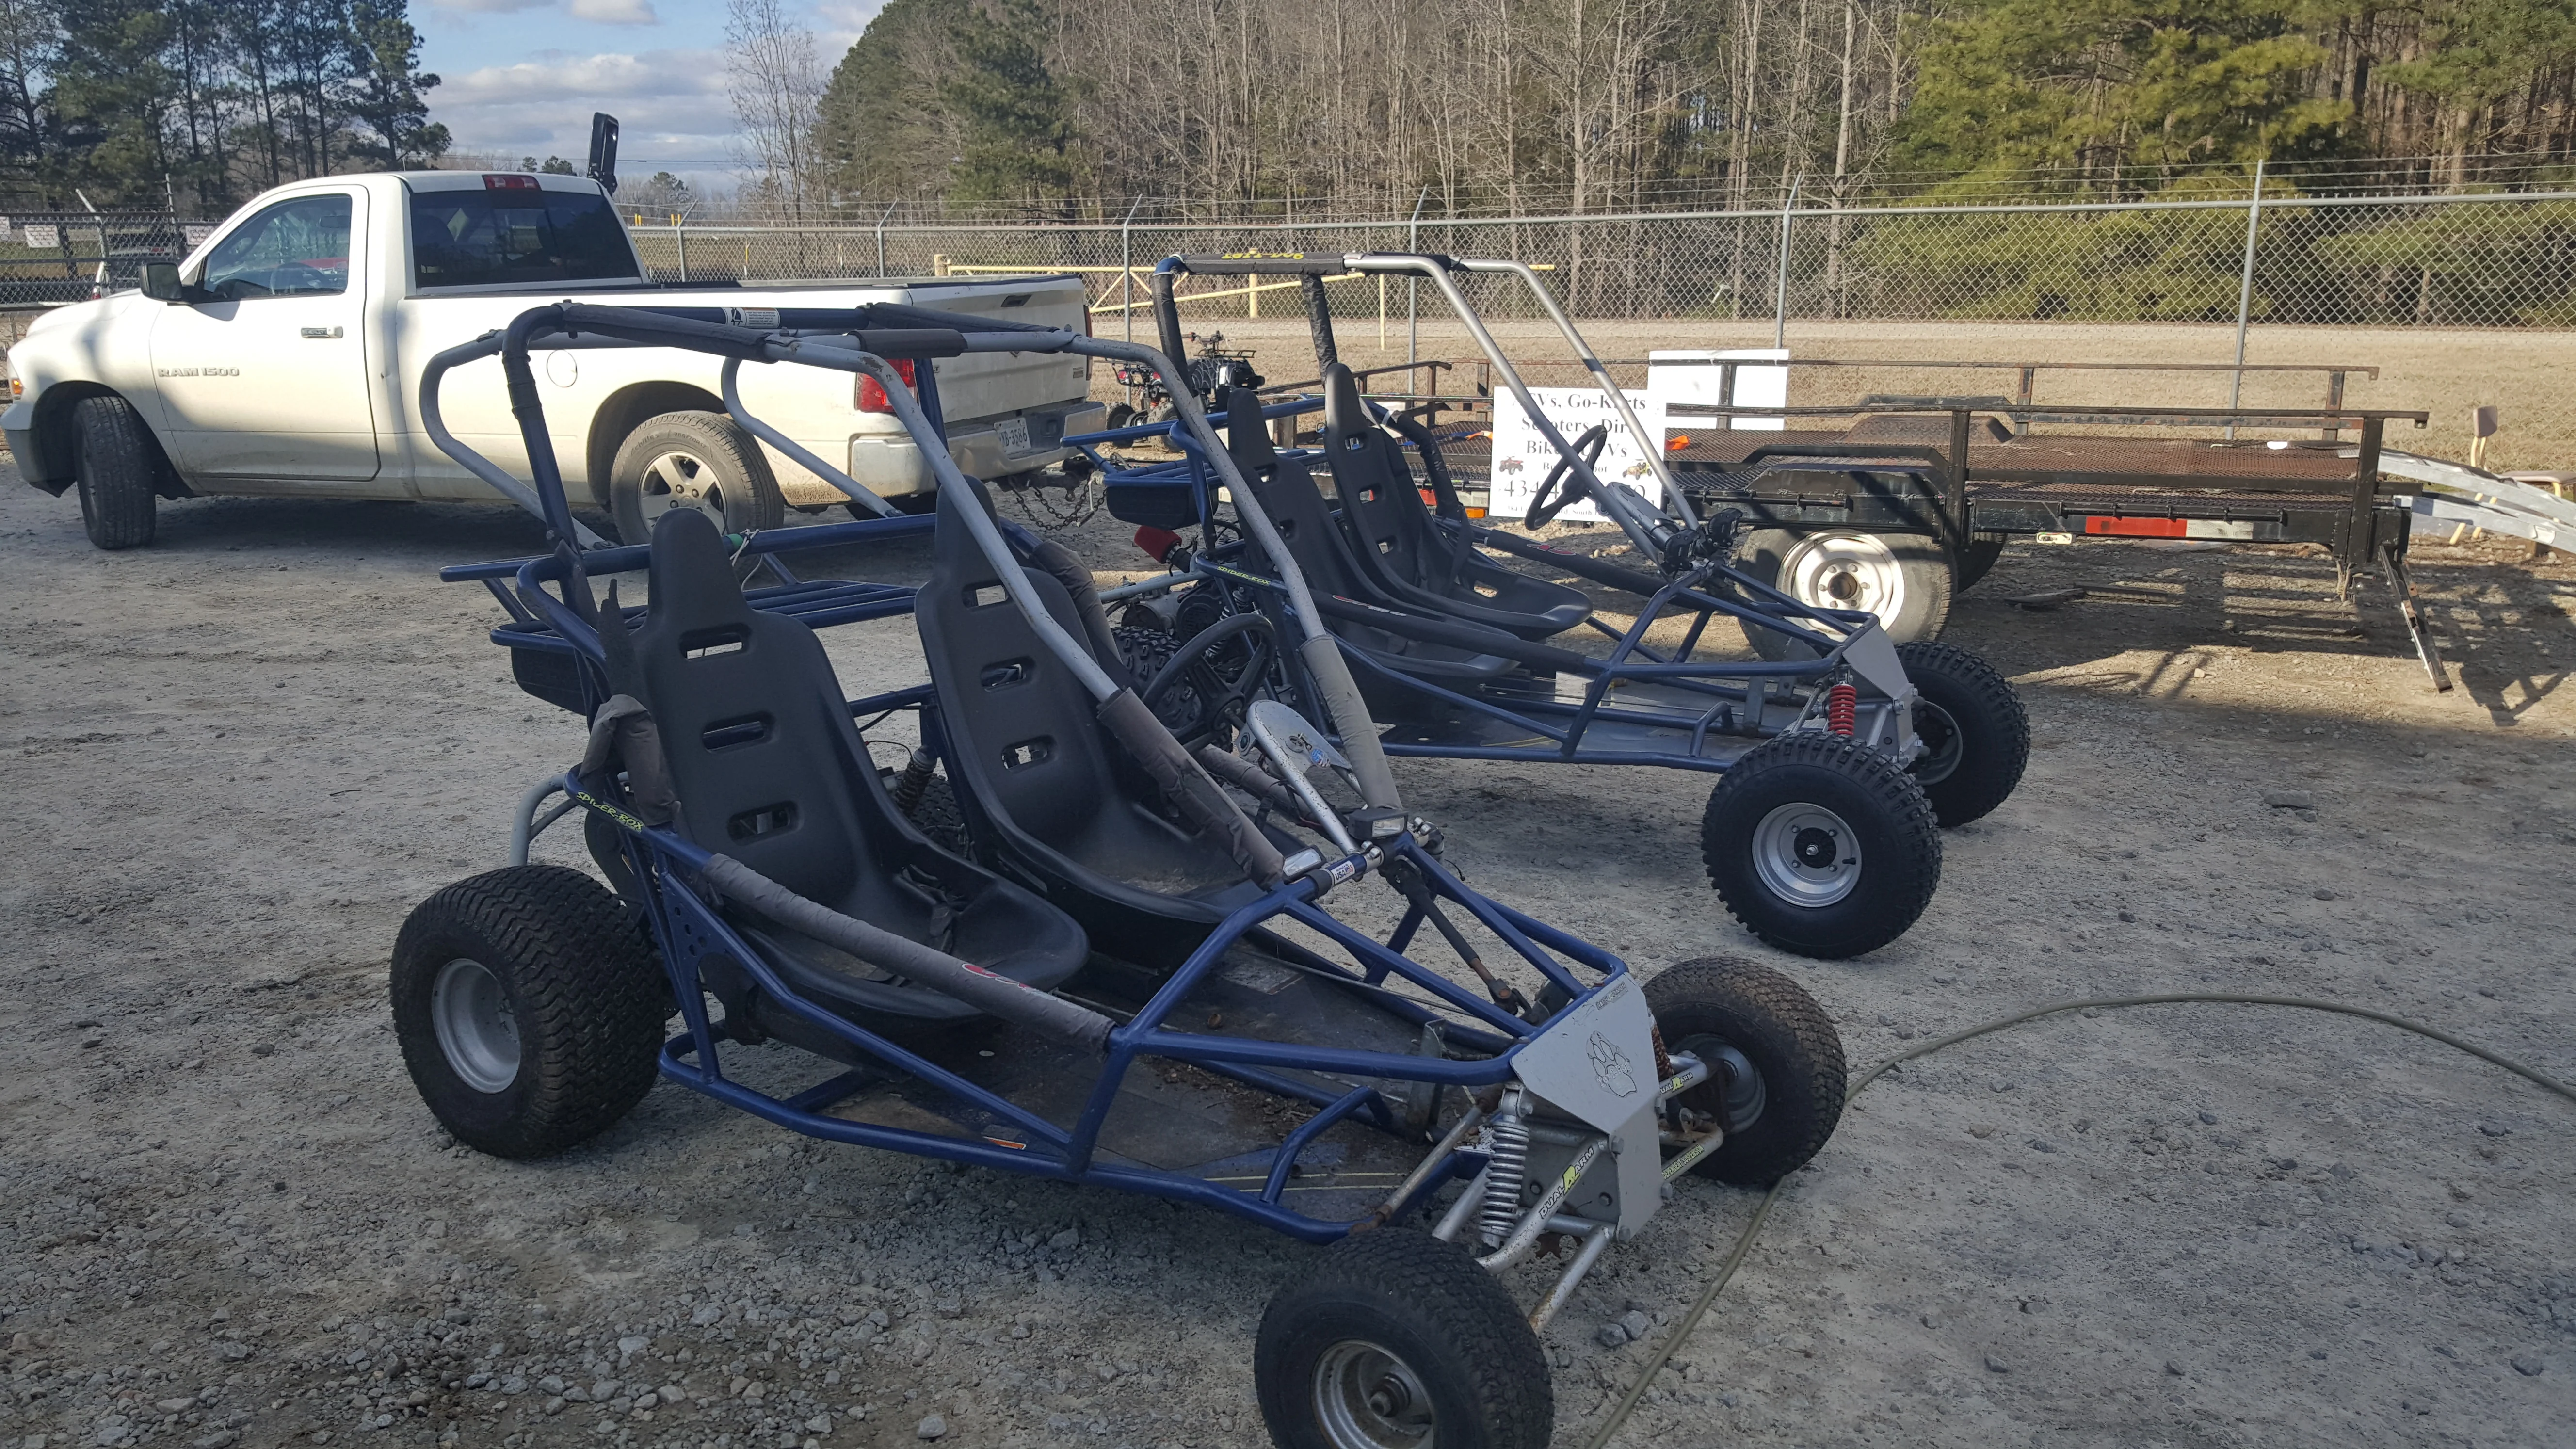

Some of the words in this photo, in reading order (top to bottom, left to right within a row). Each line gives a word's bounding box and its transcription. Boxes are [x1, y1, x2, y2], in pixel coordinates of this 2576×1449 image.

[158, 368, 199, 377] RAM
[201, 367, 240, 377] 1500
[1335, 869, 1346, 880] USA
[1680, 1072, 1693, 1083] ARM
[1539, 1185, 1565, 1219] DUAL
[1574, 1146, 1594, 1175] ARM
